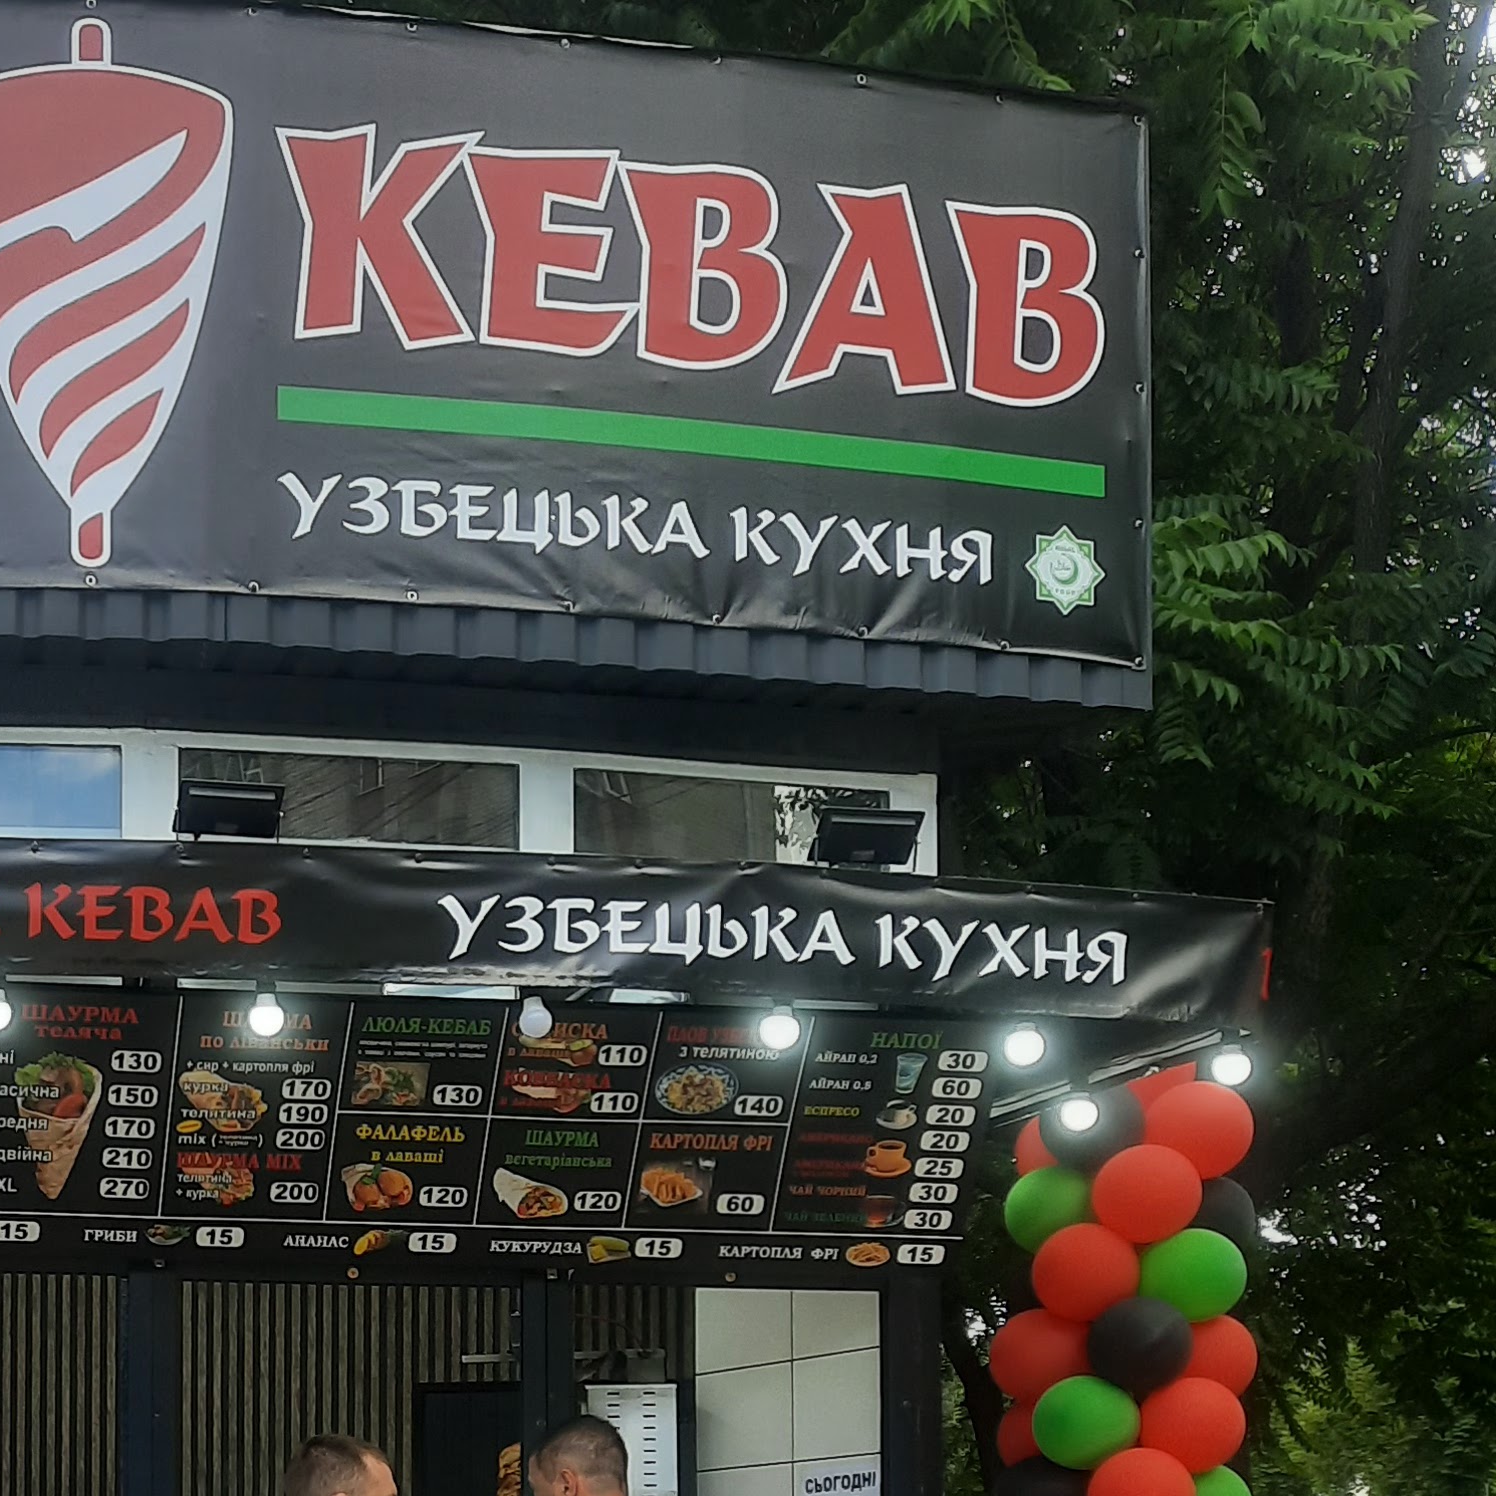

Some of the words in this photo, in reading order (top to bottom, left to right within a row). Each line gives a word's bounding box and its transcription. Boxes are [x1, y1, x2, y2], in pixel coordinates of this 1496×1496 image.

[274, 123, 1106, 408] KEBAB
[277, 472, 709, 559] УЗБЕЦЬКА
[732, 507, 994, 584] КУХНЯ
[24, 881, 283, 945] KEBAB
[437, 893, 857, 965] УЗБЕЦЬКА
[875, 912, 1129, 986] КУХНЯ
[21, 1004, 139, 1024] ШАУРМА
[34, 1025, 122, 1041] теляча
[361, 1016, 491, 1036] ЛЮЛЯ-КЕБАБ
[511, 1022, 608, 1040] СИСКА
[200, 1035, 224, 1049] ПО
[870, 1031, 944, 1050] НАПОЇ
[114, 1052, 158, 1070] 130
[602, 1046, 643, 1063] 110
[692, 1046, 779, 1061] телятиною
[815, 1051, 857, 1064] АЙРАН
[947, 1053, 976, 1070] 30
[232, 1061, 289, 1074] картопля
[291, 1060, 315, 1075] фрі
[183, 1082, 229, 1094] курка
[285, 1081, 328, 1098] 170
[437, 1086, 480, 1103] 130
[809, 1077, 850, 1090] АЙРАН
[942, 1080, 970, 1096] 60
[110, 1087, 154, 1105] 150
[594, 1094, 635, 1111] 110
[737, 1097, 779, 1114] 140
[180, 1108, 256, 1120] телятина
[282, 1106, 325, 1123] 190
[804, 1106, 860, 1117] ЕСПРЕСО
[935, 1107, 965, 1124] 20
[108, 1119, 151, 1136] 170
[355, 1123, 466, 1143] ФАЛАФЕЛЬ
[178, 1133, 206, 1145] mix
[280, 1131, 323, 1148] 200
[525, 1129, 599, 1147] ШАУРМА
[650, 1133, 739, 1150] КАРТОПЛЯ
[743, 1135, 773, 1151] ФРІ
[930, 1133, 959, 1149] 20
[106, 1149, 150, 1167] 210
[370, 1151, 381, 1161] в
[385, 1149, 444, 1163] лаваші
[505, 1153, 612, 1169] вегетаріанська
[924, 1160, 954, 1176] 25
[104, 1180, 148, 1197] 270
[185, 1189, 219, 1200] курка
[274, 1184, 318, 1201] 200
[423, 1188, 464, 1204] 120
[789, 1184, 813, 1195] ЧАЙ
[816, 1185, 868, 1197] ЧОРНИЙ
[919, 1185, 947, 1201] 30
[577, 1193, 618, 1209] 120
[726, 1195, 754, 1213] 60
[914, 1212, 942, 1228] 30
[0, 1223, 29, 1240] 15
[84, 1229, 137, 1242] ГРИБИ
[206, 1229, 234, 1245] 15
[283, 1234, 349, 1248] АНАНАС
[417, 1234, 445, 1250] 15
[490, 1240, 582, 1256] КУКУРУДЗА
[644, 1239, 672, 1256] 15
[718, 1245, 802, 1260] КАРТОПЛЯ
[810, 1247, 839, 1261] ФРІ
[906, 1246, 934, 1263] 15
[804, 1471, 877, 1494] СЬОГОДНІ
